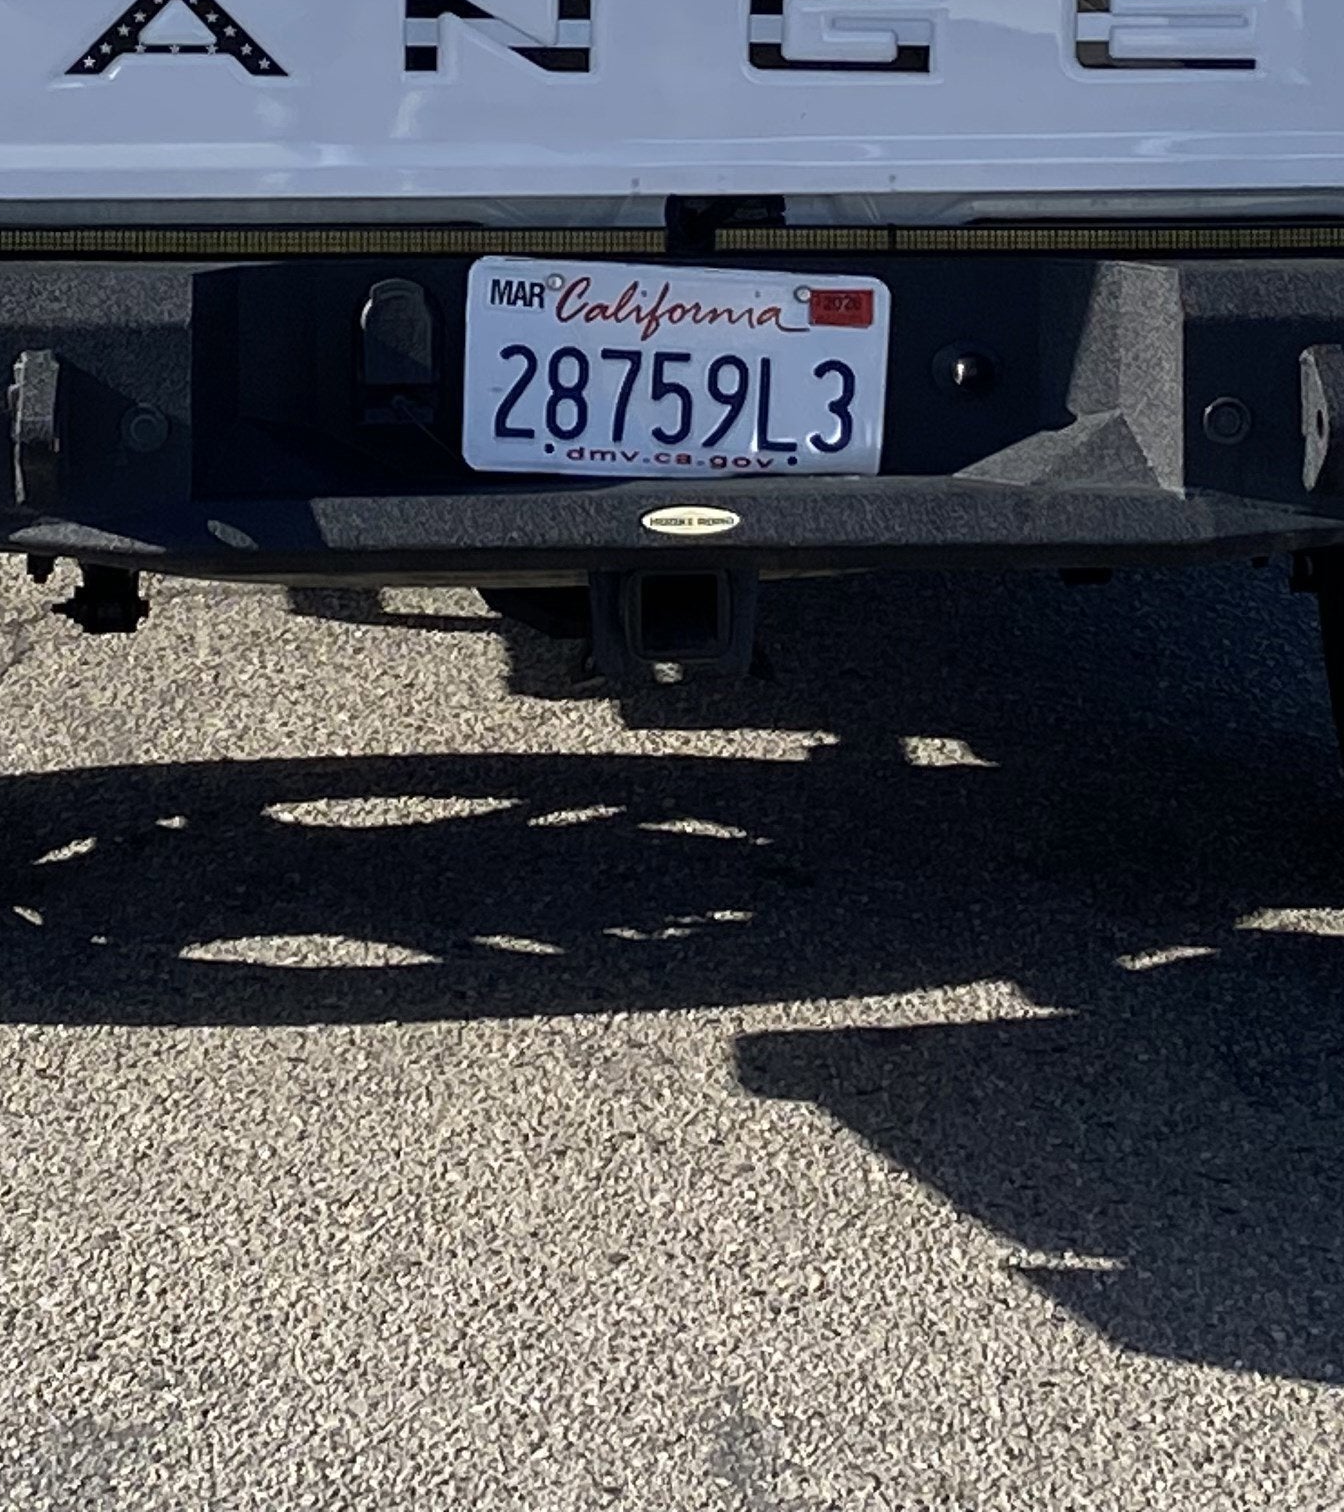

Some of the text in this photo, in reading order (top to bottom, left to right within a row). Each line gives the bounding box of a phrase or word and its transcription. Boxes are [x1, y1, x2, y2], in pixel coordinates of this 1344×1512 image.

[490, 278, 545, 309] MAR
[556, 275, 810, 342] California
[493, 343, 858, 454] 28759L3
[565, 445, 775, 471] dmv.ca.gov
